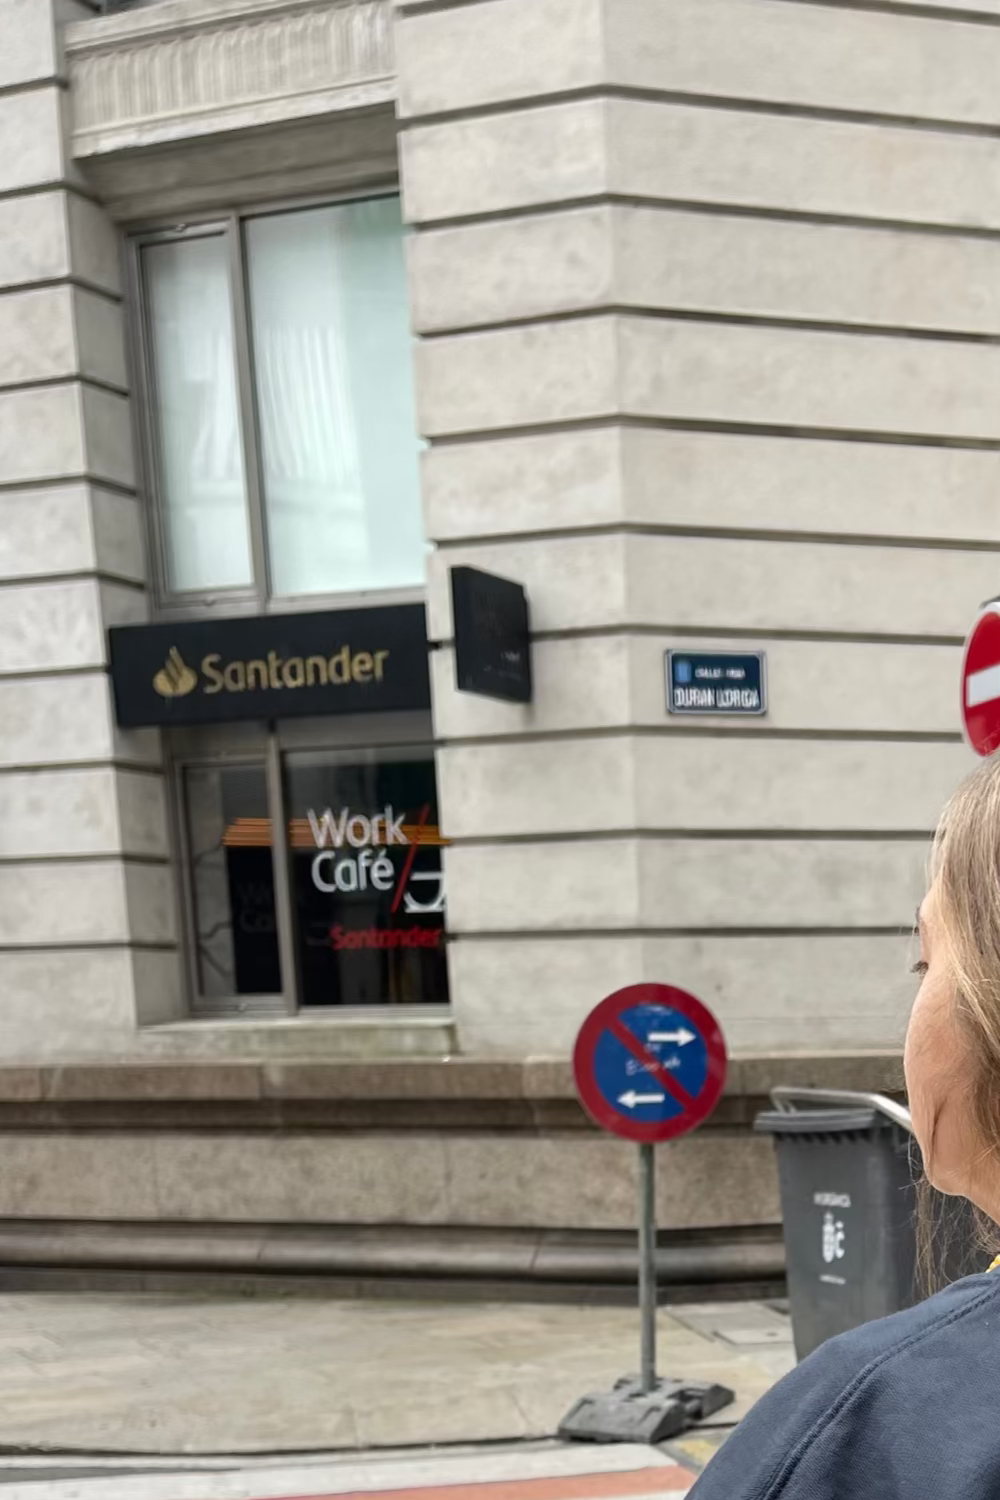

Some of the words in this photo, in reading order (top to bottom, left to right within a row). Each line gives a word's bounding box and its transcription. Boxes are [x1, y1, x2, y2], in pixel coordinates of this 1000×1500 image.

[201, 645, 390, 694] Santander
[307, 804, 408, 849] Work
[311, 850, 394, 892] Café
[329, 922, 442, 950] Santander
